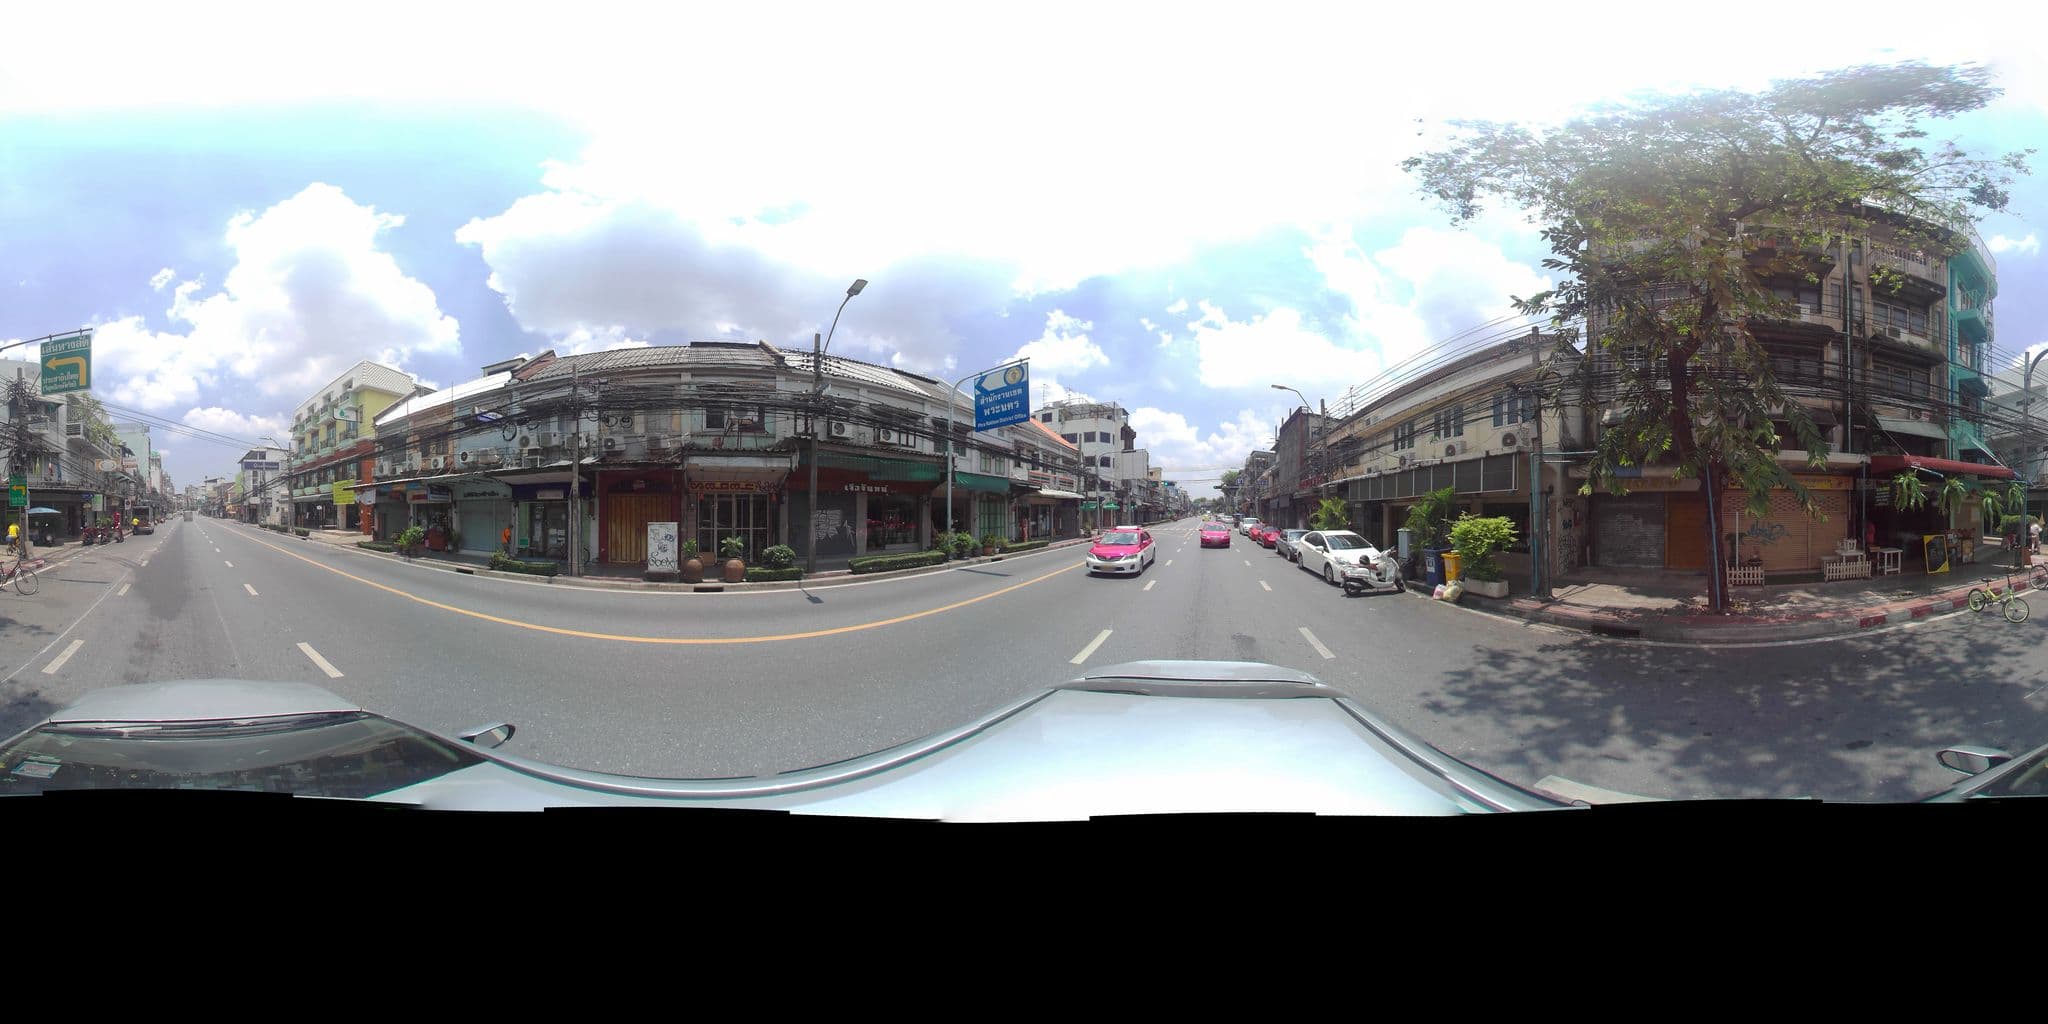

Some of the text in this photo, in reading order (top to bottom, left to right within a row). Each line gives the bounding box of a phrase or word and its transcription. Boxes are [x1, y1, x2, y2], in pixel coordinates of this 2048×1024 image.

[980, 388, 1023, 405] สำนักงานเขต
[983, 400, 1020, 416] พระนคร
